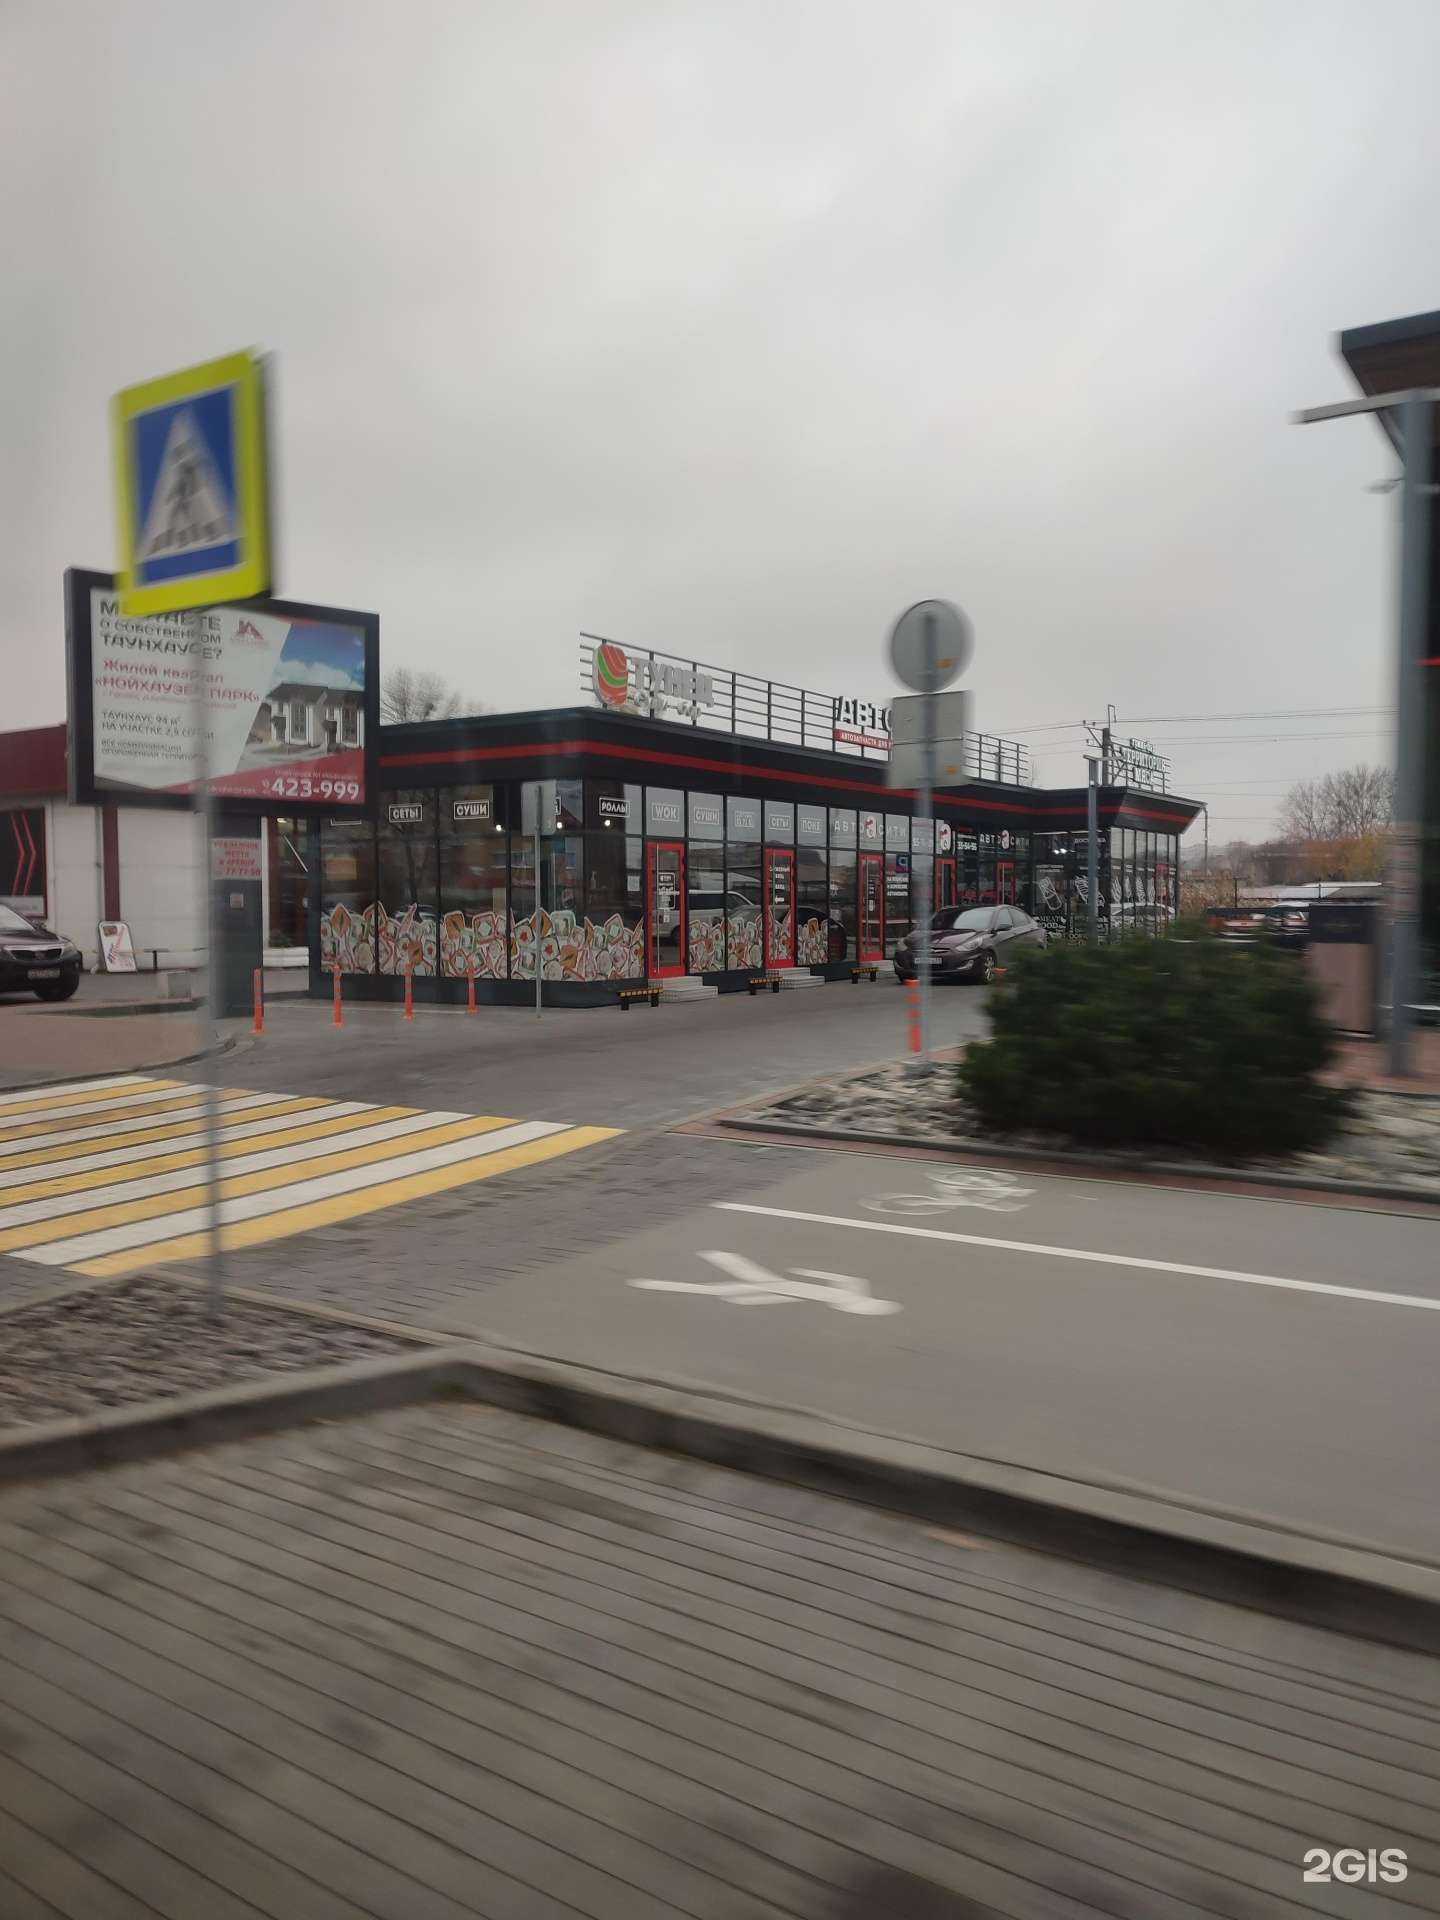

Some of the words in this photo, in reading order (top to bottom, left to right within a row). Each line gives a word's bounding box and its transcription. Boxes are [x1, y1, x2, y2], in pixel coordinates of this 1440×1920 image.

[271, 777, 360, 799] 423-999
[392, 808, 420, 819] СЕТЫ
[456, 803, 488, 816] СУШИ
[601, 802, 628, 814] РОЛЛЫ
[655, 805, 677, 819] WOK
[695, 808, 719, 821] СУШИ
